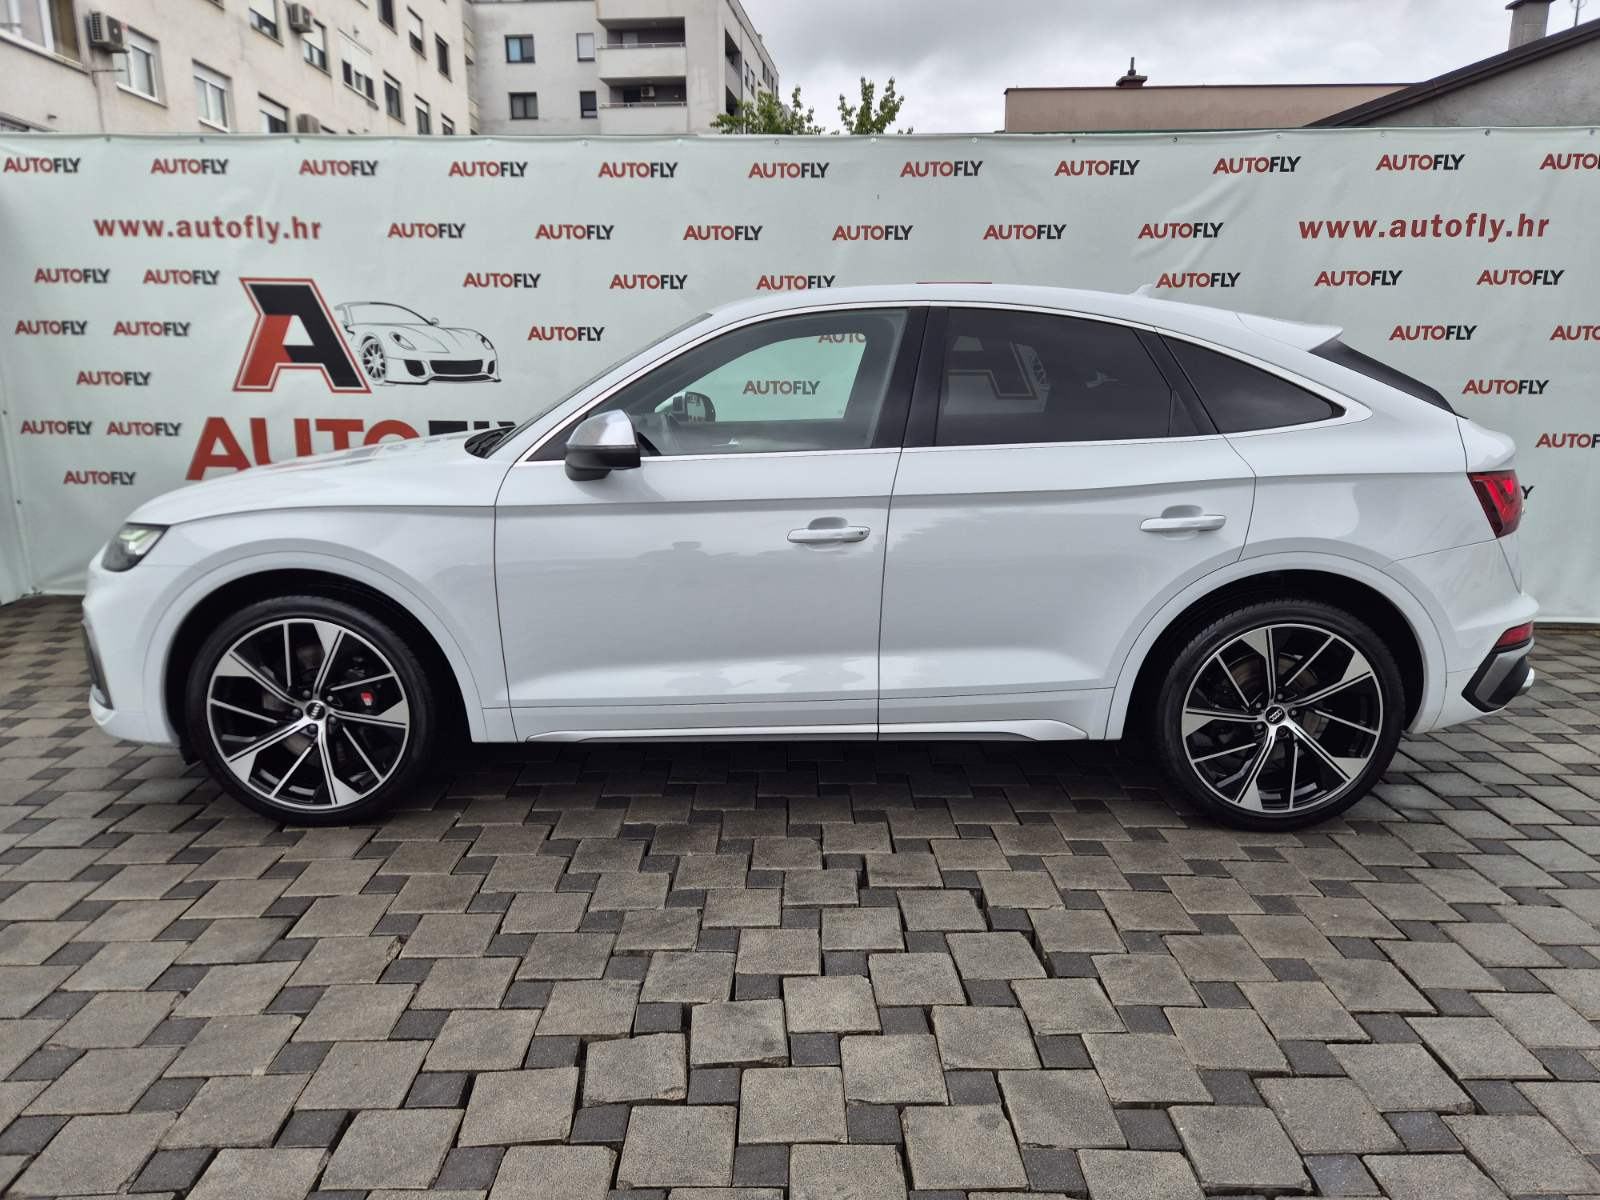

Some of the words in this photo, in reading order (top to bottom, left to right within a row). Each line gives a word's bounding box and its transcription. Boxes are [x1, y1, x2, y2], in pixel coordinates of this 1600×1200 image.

[3, 157, 81, 173] AUTOFLY
[151, 159, 229, 175] AUTOFLY
[299, 160, 379, 176] AUTOFLY
[448, 161, 528, 177] AUTOFLY
[900, 160, 983, 177] AUTOFLY
[1056, 160, 1140, 176] AUTOFLY
[1213, 156, 1301, 174] AUTOFLY
[1376, 154, 1465, 171] AUTOFLY
[1539, 153, 1600, 170] AUTO
[598, 162, 678, 178] AUTOFLY
[748, 162, 829, 178] AUTOFLY
[93, 215, 321, 244] www.autofly.hr
[388, 223, 466, 239] AUTOFLY
[535, 224, 614, 240] AUTOFLY
[683, 225, 763, 240] AUTOFLY
[832, 225, 913, 240] AUTOFLY
[983, 224, 1067, 240] AUTOFLY
[1138, 222, 1224, 239] AUTOFLY
[1299, 213, 1549, 243] www.autofly.hr
[35, 268, 110, 284] AUTOFLY
[143, 269, 220, 285] AUTOFLY
[463, 273, 541, 288] AUTOFLY
[610, 274, 688, 289] AUTOFLY
[1156, 272, 1241, 288] AUTOFLY
[1314, 270, 1403, 286] AUTOFLY
[1477, 270, 1565, 285] AUTOFLY
[15, 320, 88, 335] AUTOFLY
[113, 321, 191, 337] AUTOFLY
[528, 326, 605, 341] AUTOFLY
[1389, 325, 1477, 340] AUTOFLY
[77, 371, 151, 386] AUTOFLY
[743, 381, 820, 395] AUTOFLY
[1462, 380, 1549, 394] AUTOFLY
[21, 421, 92, 435] AUTOFLY
[107, 422, 182, 436] AUTOFLY
[64, 471, 136, 485] AUTOFLY
